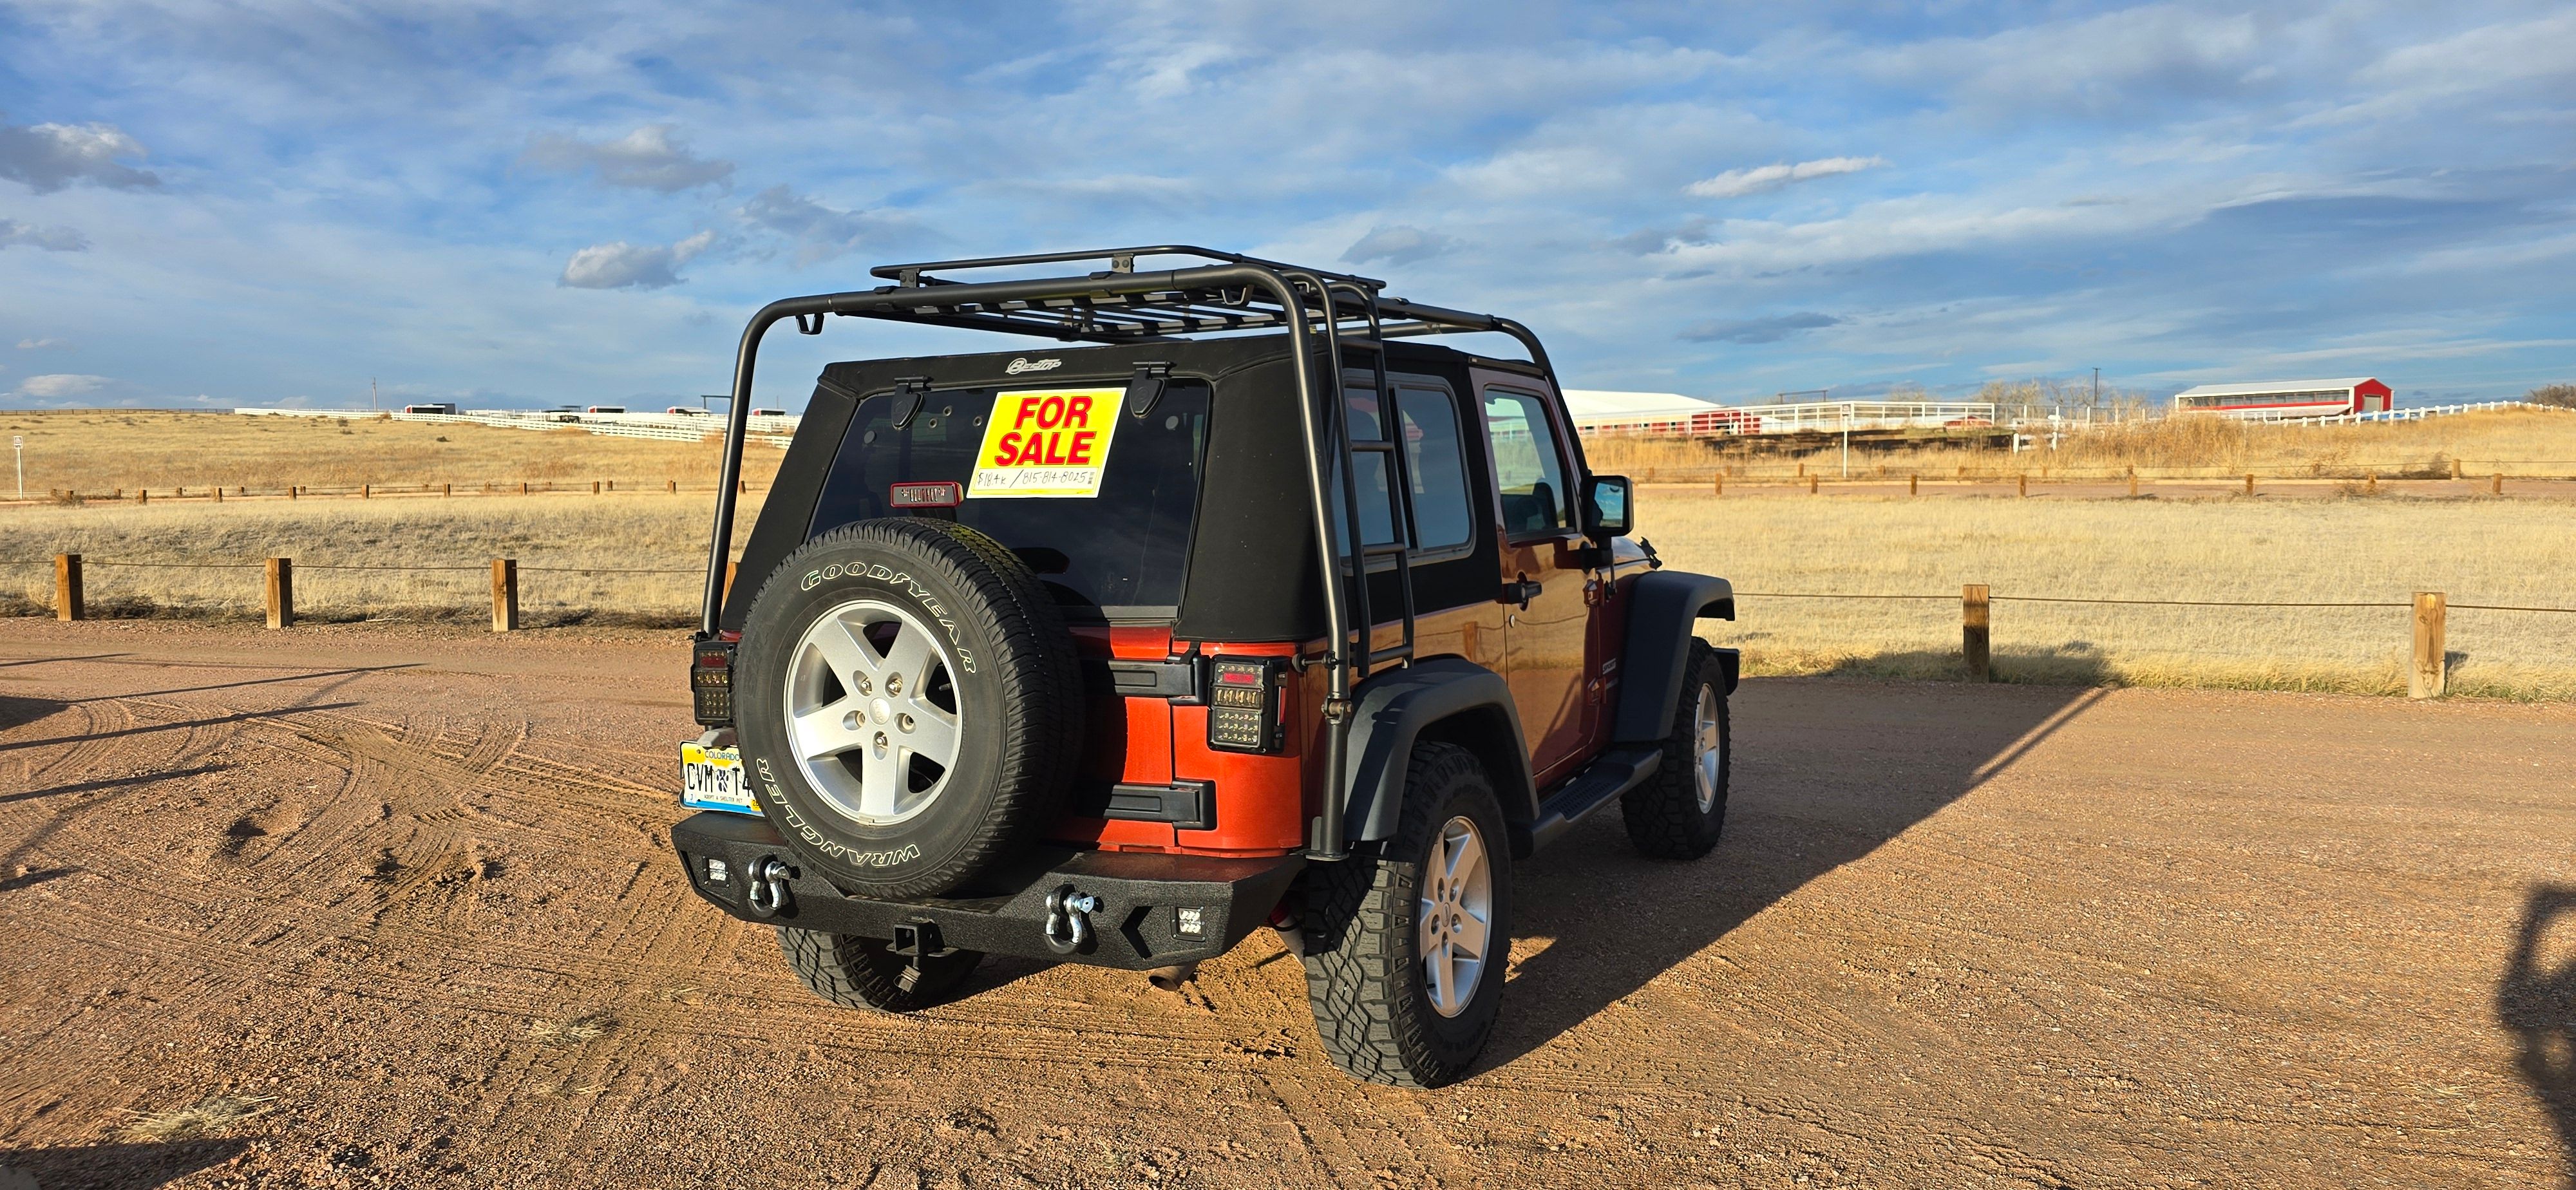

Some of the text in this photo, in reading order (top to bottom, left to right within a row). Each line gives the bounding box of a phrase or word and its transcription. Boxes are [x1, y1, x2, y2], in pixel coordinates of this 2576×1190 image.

[1014, 395, 1093, 430] FOR
[994, 431, 1097, 466] SALE
[800, 562, 976, 674] GOODYEAR
[705, 750, 740, 762] COLORADO
[687, 762, 713, 793] CVM
[756, 758, 920, 867] WRANGLER
